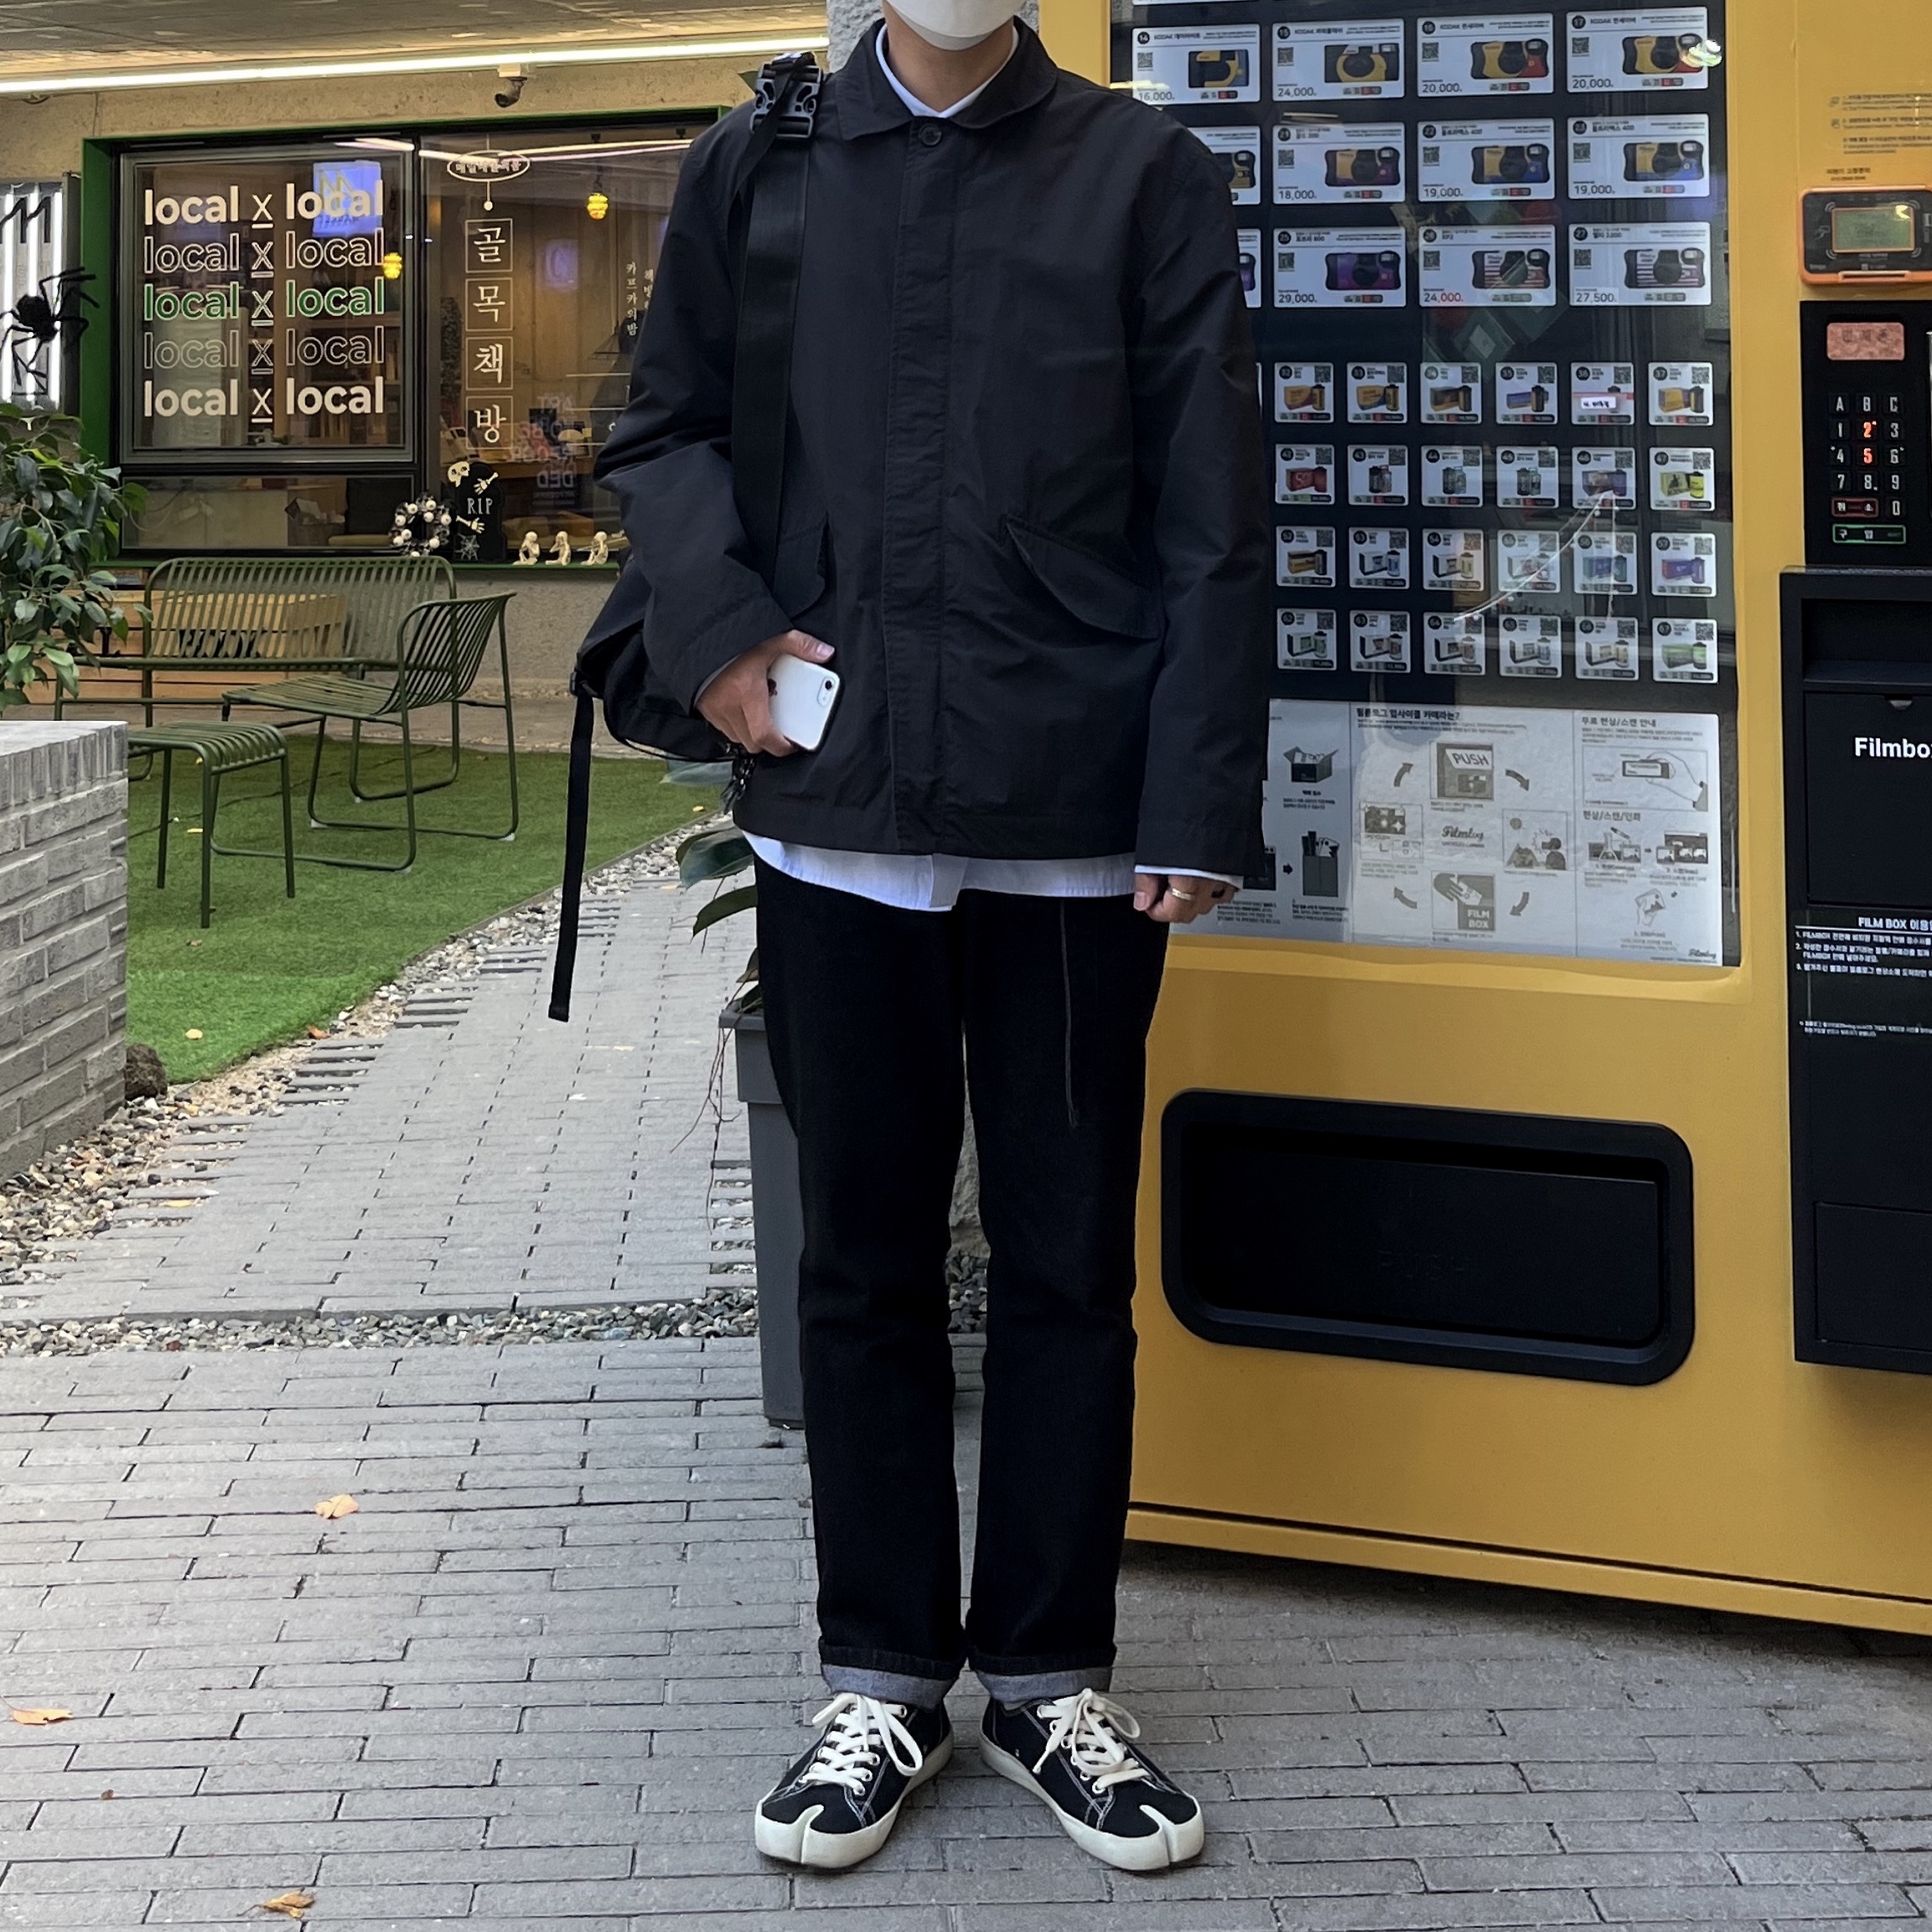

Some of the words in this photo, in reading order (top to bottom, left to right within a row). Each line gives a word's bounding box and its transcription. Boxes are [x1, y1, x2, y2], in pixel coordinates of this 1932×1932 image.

[144, 185, 239, 225] local
[252, 194, 273, 221] x
[287, 179, 383, 220] local
[144, 232, 240, 273] local
[252, 241, 273, 271] x
[287, 227, 384, 268] local
[143, 281, 240, 321] local
[252, 290, 273, 319] x
[287, 277, 384, 318] local
[473, 227, 506, 443] 골목책방
[143, 329, 240, 369] local
[252, 339, 273, 367] x
[287, 326, 384, 365] local
[144, 378, 239, 417] local
[252, 388, 273, 415] x
[287, 376, 383, 415] local
[1836, 396, 1844, 412] A
[1863, 396, 1871, 412] B
[1890, 396, 1898, 412] C
[1838, 422, 1842, 438] 1
[1863, 422, 1872, 438] 2
[1890, 422, 1898, 438] 3
[1836, 448, 1844, 463] 4
[1864, 448, 1872, 464] 5
[1890, 448, 1898, 464] 6
[1837, 474, 1845, 489] 7
[1864, 474, 1872, 489] 8
[1892, 474, 1899, 489] 9
[1855, 737, 1932, 759] Filmbo
[1452, 753, 1489, 765] PUSH
[1468, 909, 1489, 919] FILM
[1468, 919, 1489, 929] BOX
[1858, 916, 1883, 928] FILM
[1886, 918, 1907, 930] BOX
